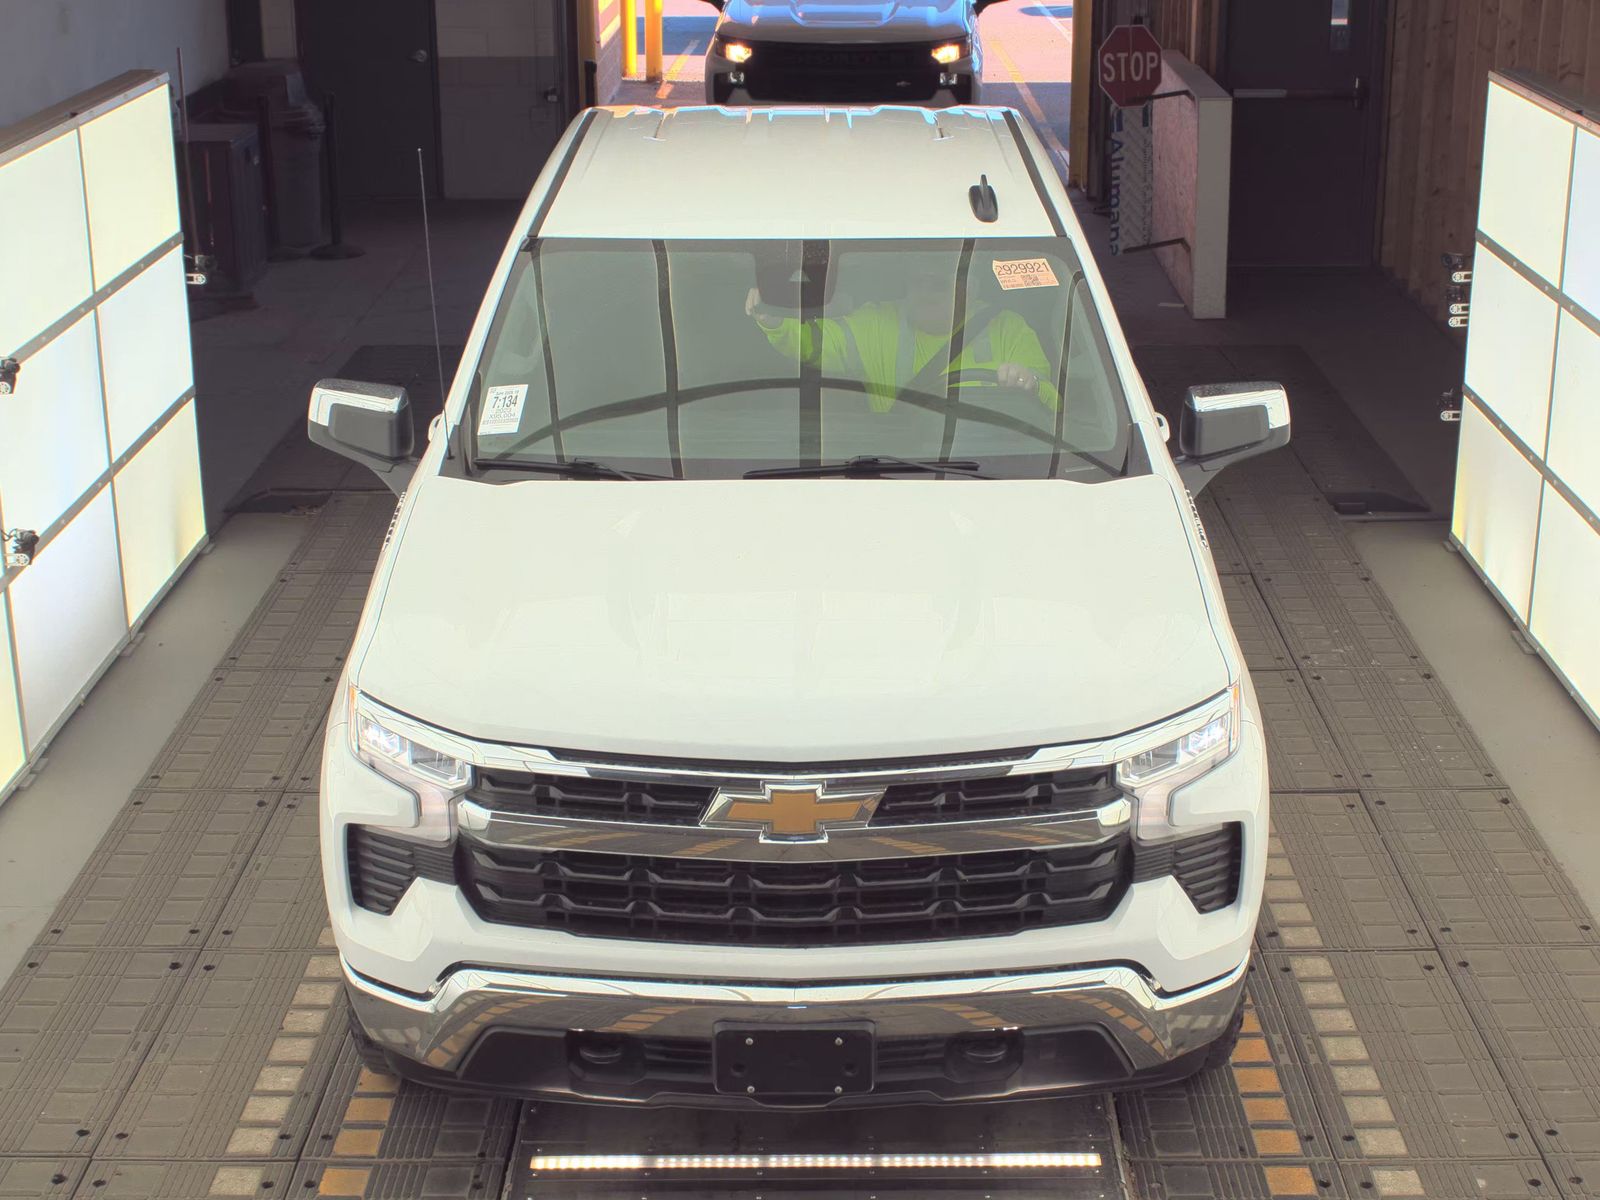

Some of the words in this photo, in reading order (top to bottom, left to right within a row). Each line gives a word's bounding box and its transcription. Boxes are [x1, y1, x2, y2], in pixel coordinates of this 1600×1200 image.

[1103, 51, 1158, 82] STOP
[996, 262, 1050, 276] 2929921
[492, 395, 518, 408] 7:134
